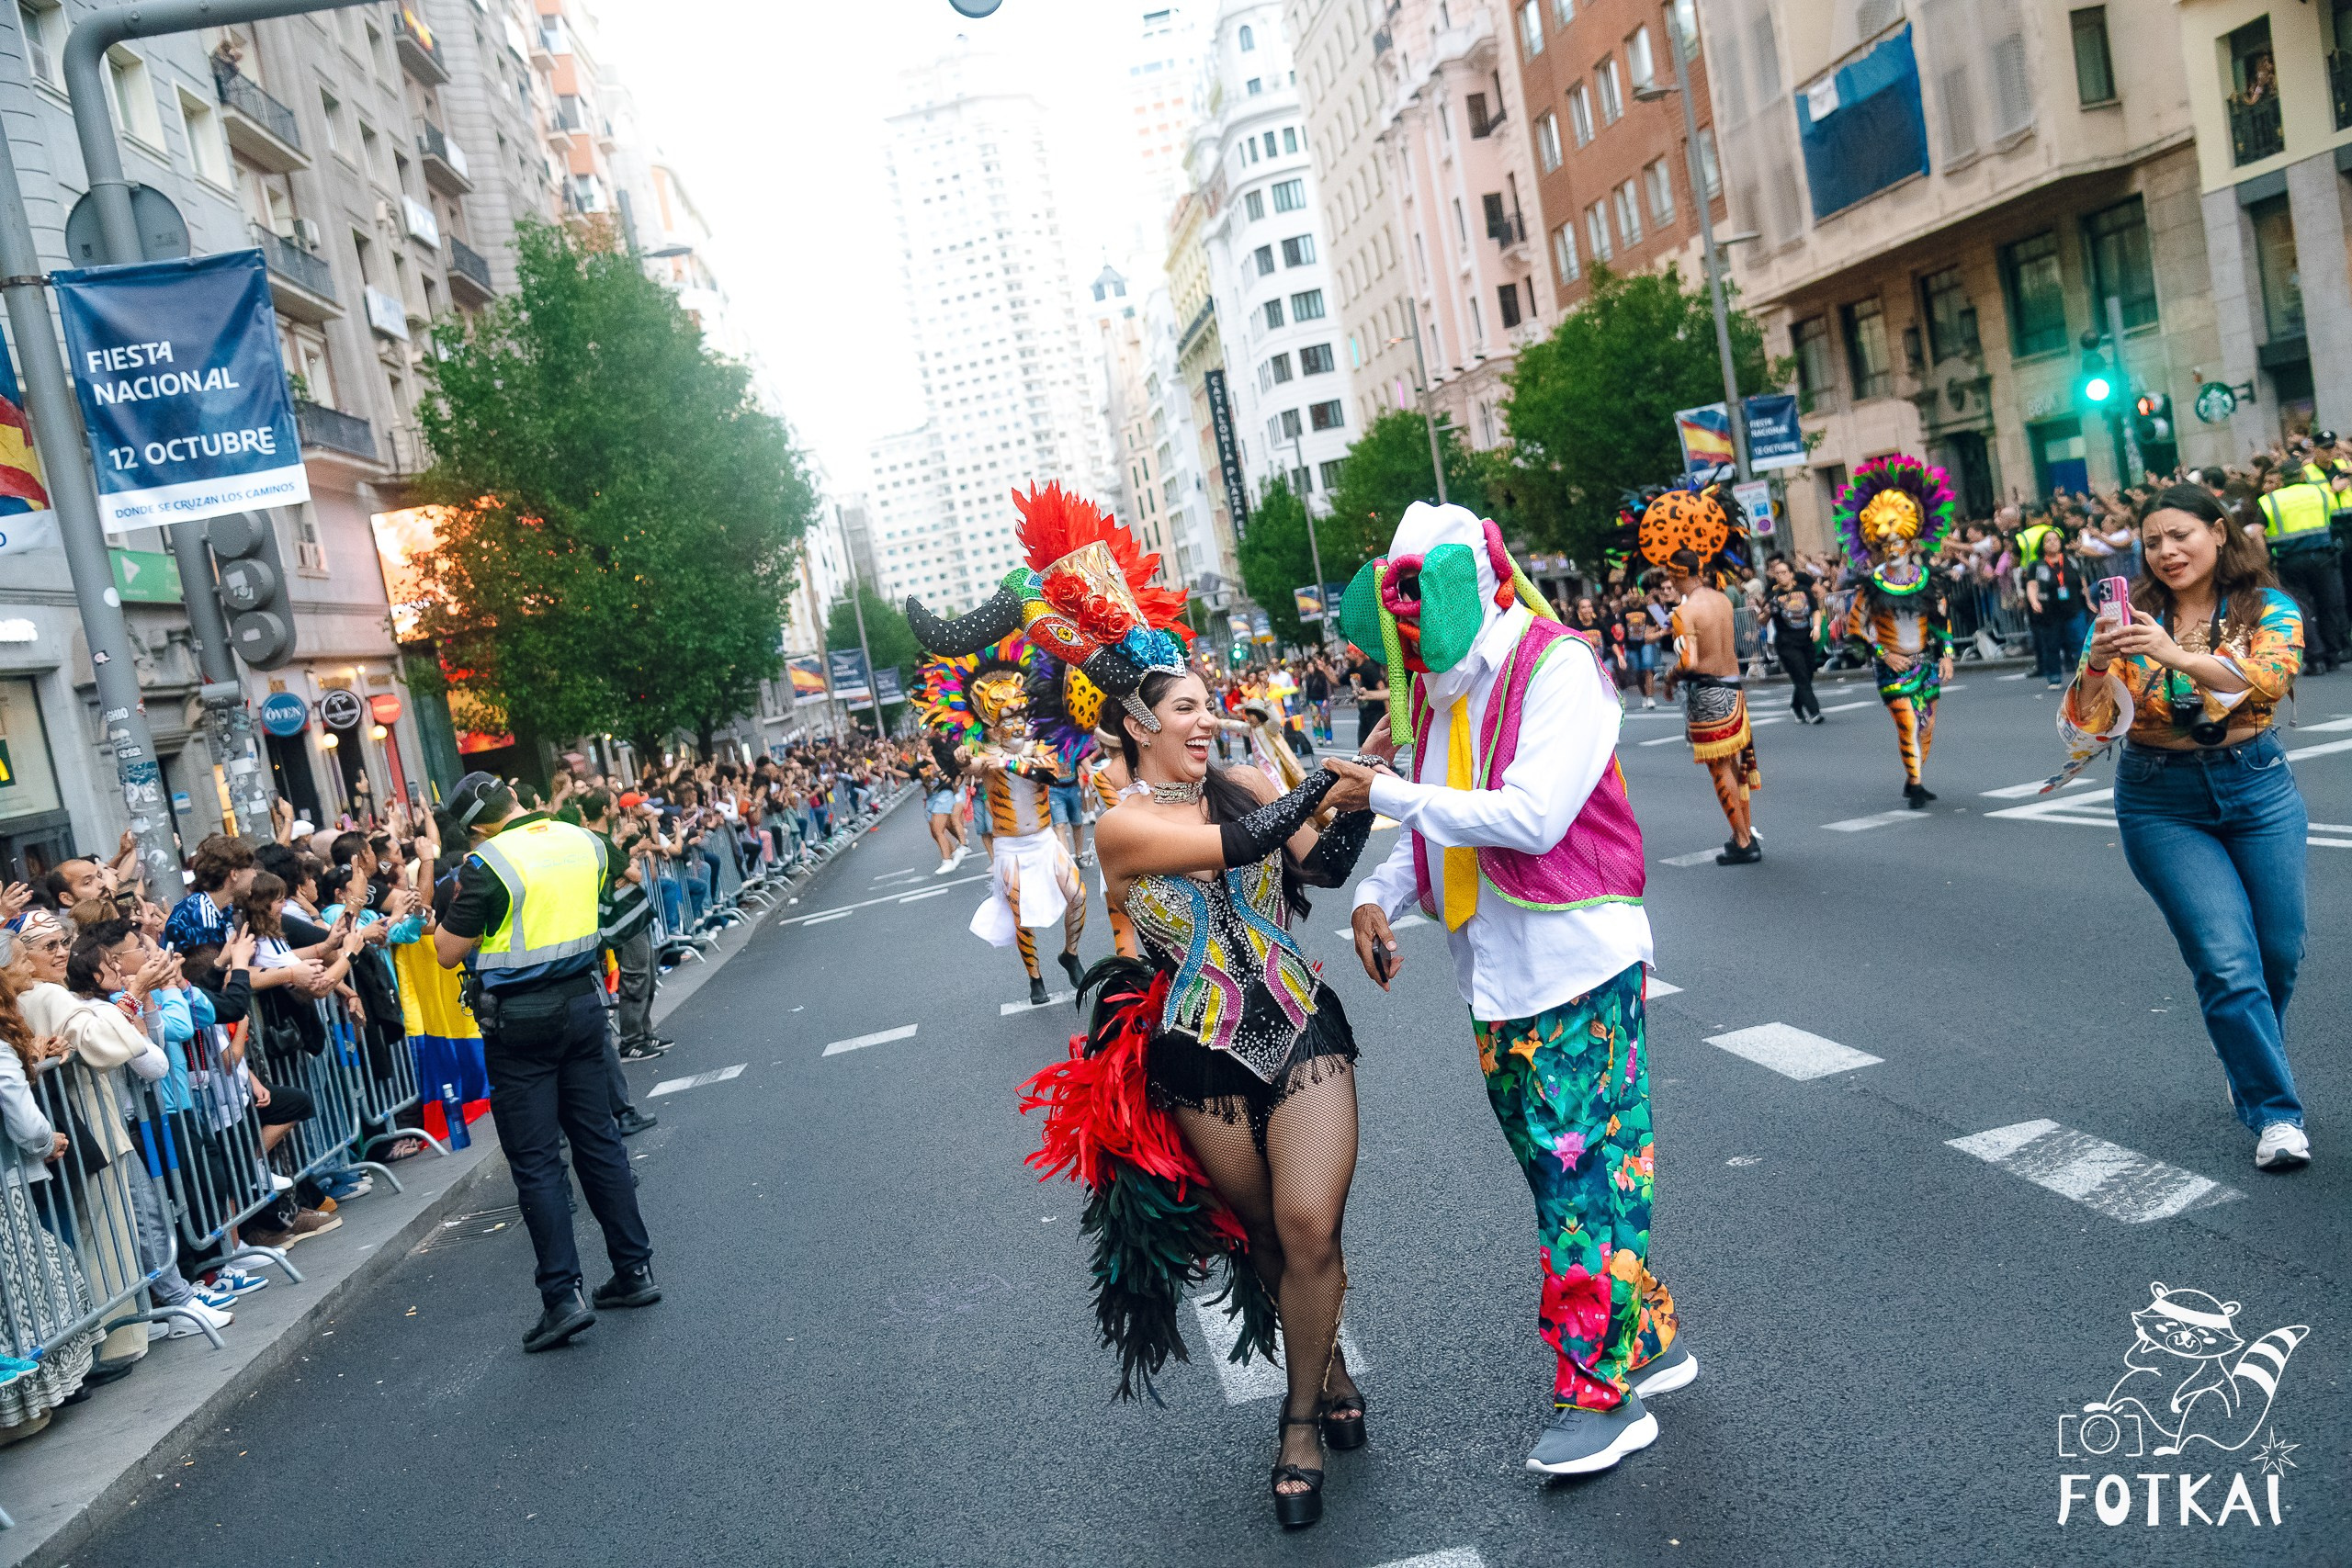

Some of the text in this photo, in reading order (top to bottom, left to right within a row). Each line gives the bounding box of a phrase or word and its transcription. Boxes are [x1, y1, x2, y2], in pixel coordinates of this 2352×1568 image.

[86, 341, 174, 374] FIESTA
[93, 367, 240, 406] NACIONAL
[108, 426, 276, 471] 12 OCTUBRE
[1210, 376, 1233, 461] CATALONIA
[1227, 467, 1243, 516] PLAZA
[115, 481, 295, 519] DONDE SE CRUZAN LOS CAMINOS
